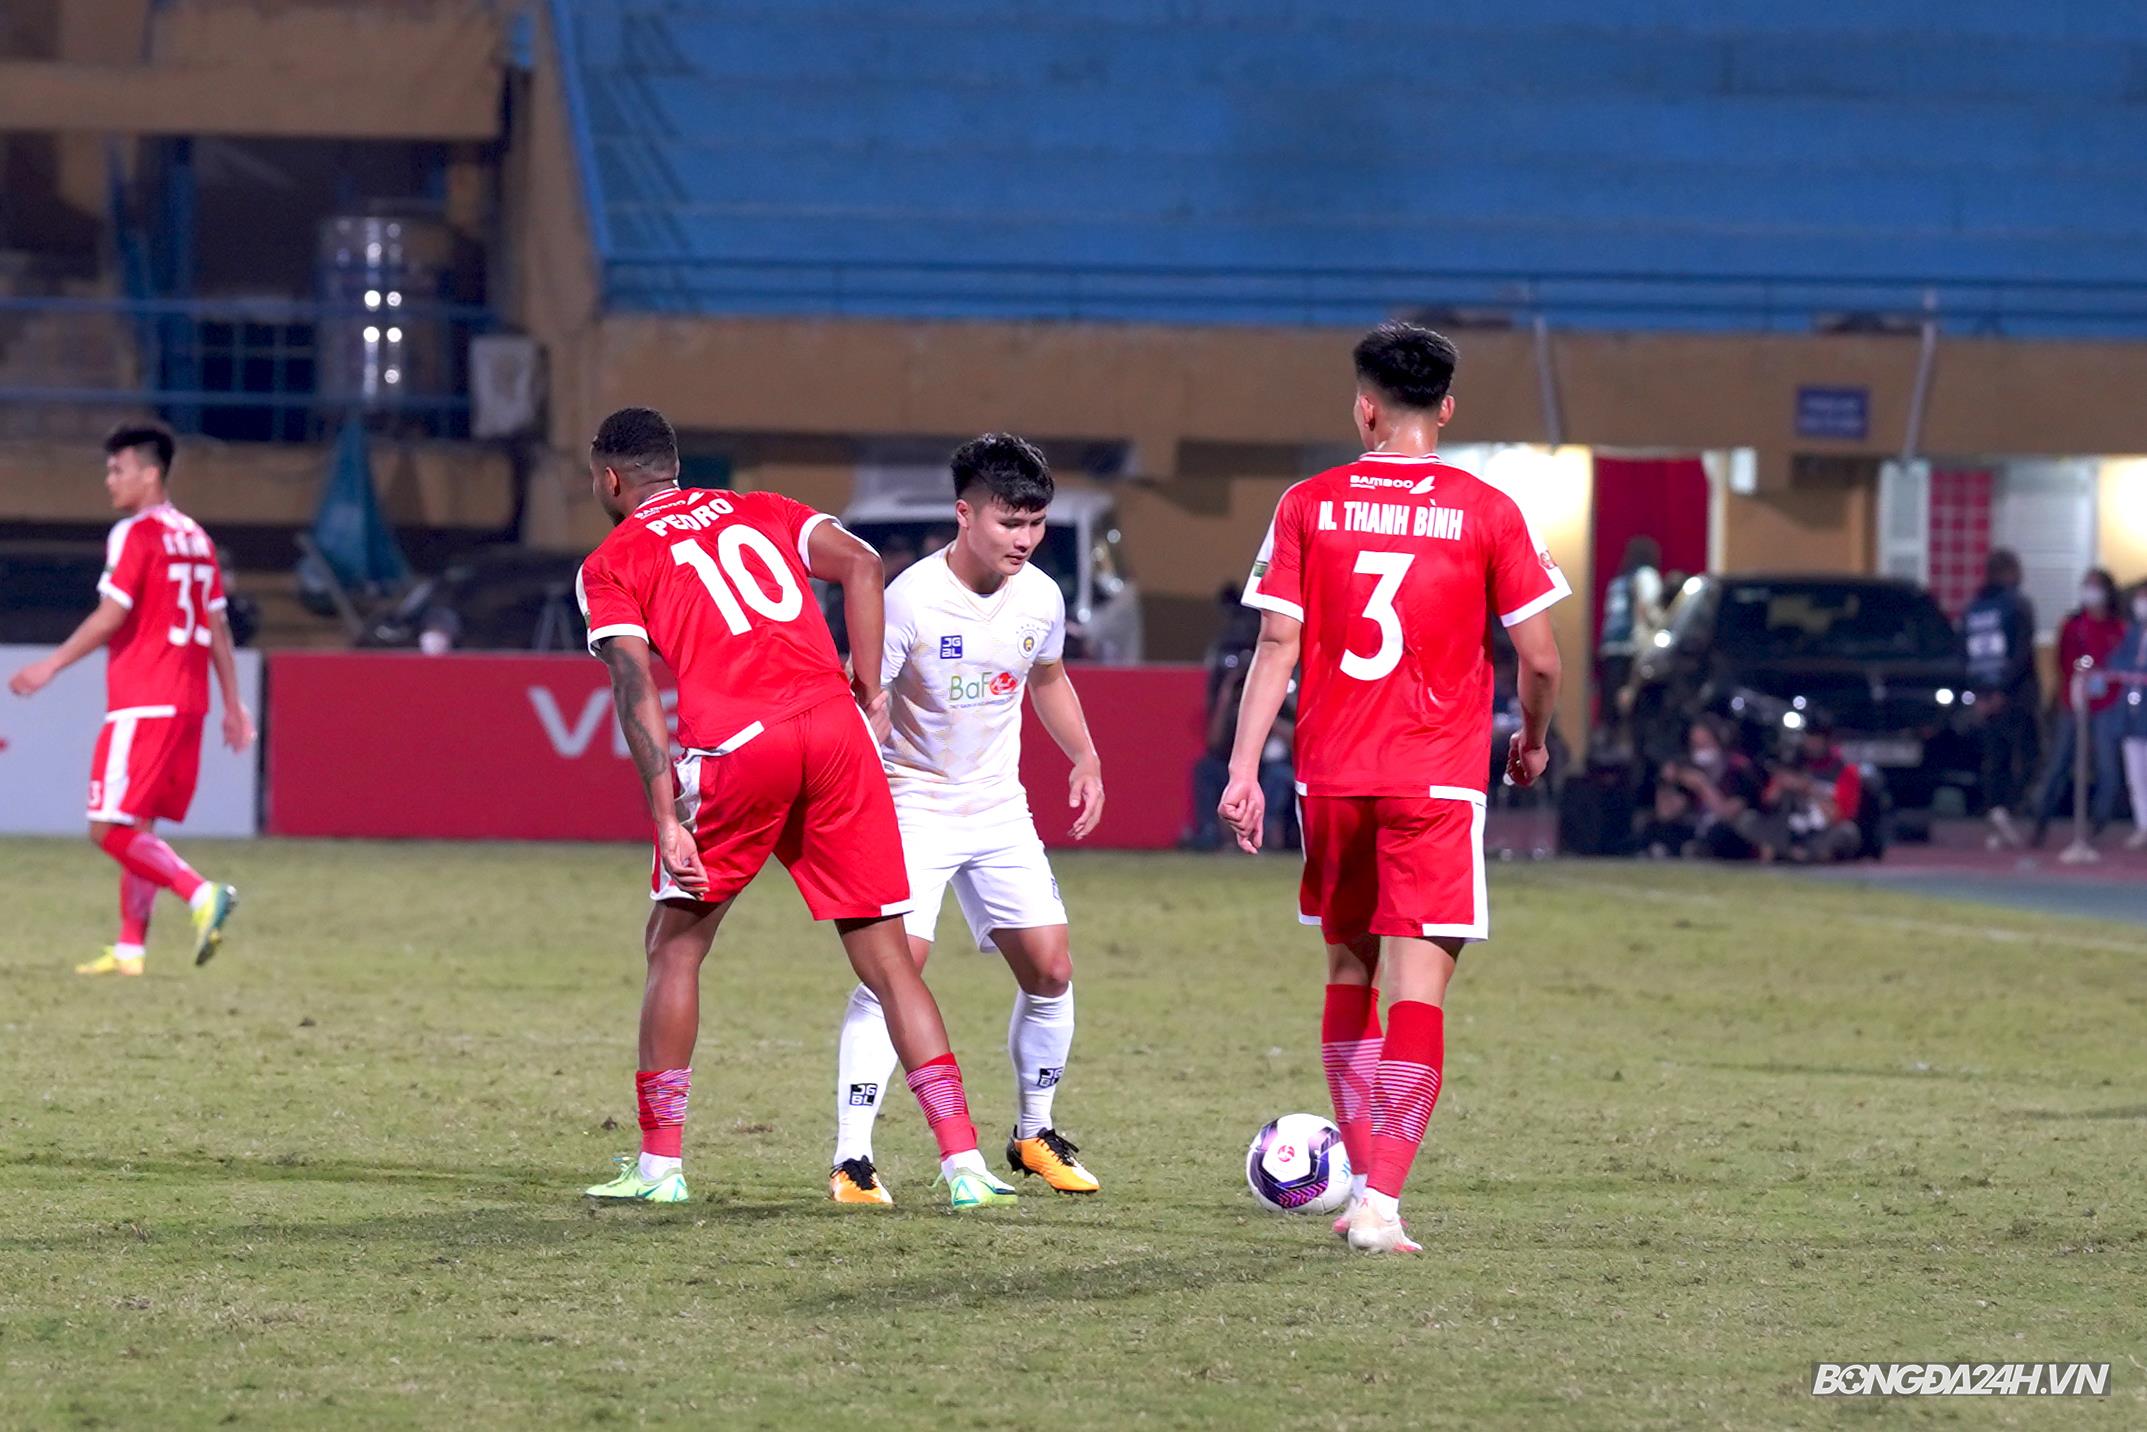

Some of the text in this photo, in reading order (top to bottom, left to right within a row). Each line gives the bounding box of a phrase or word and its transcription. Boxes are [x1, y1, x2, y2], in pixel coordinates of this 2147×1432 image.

[1349, 474, 1414, 489] BAMBOO
[645, 498, 735, 537] PEDRO
[1318, 499, 1463, 540] N. THANH BÌNH
[670, 524, 803, 637] 10
[1338, 550, 1416, 682] 3
[949, 672, 993, 701] BaF
